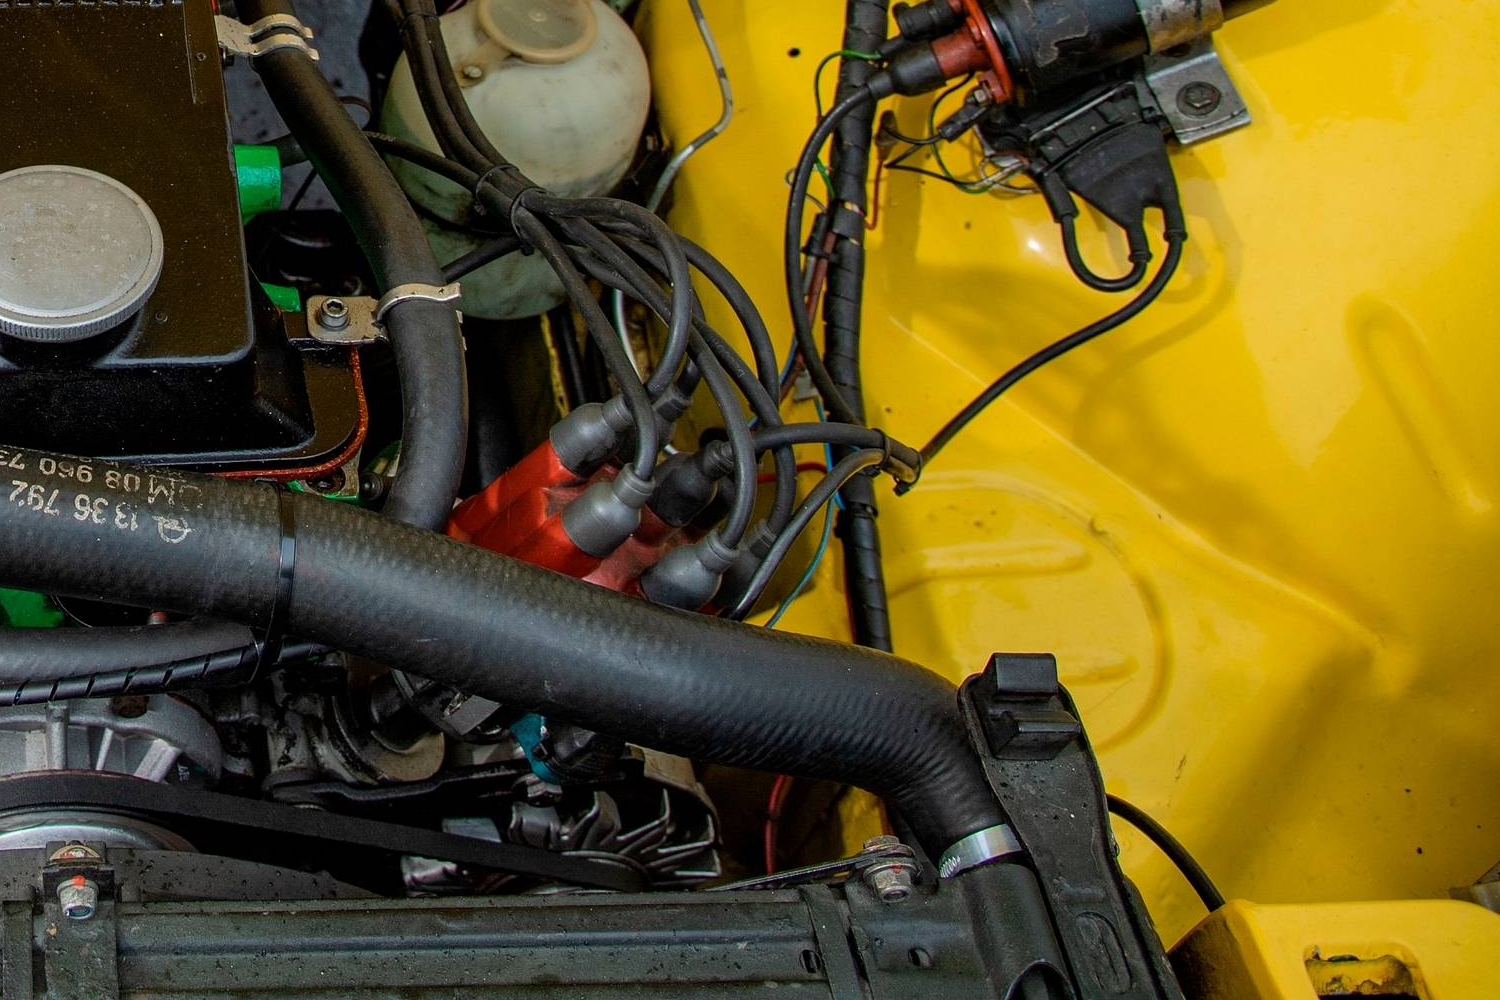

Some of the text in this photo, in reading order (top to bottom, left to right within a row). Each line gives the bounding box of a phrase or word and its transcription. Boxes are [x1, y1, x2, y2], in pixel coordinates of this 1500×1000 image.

[105, 470, 141, 493] 08
[9, 480, 139, 531] 13 36 792
